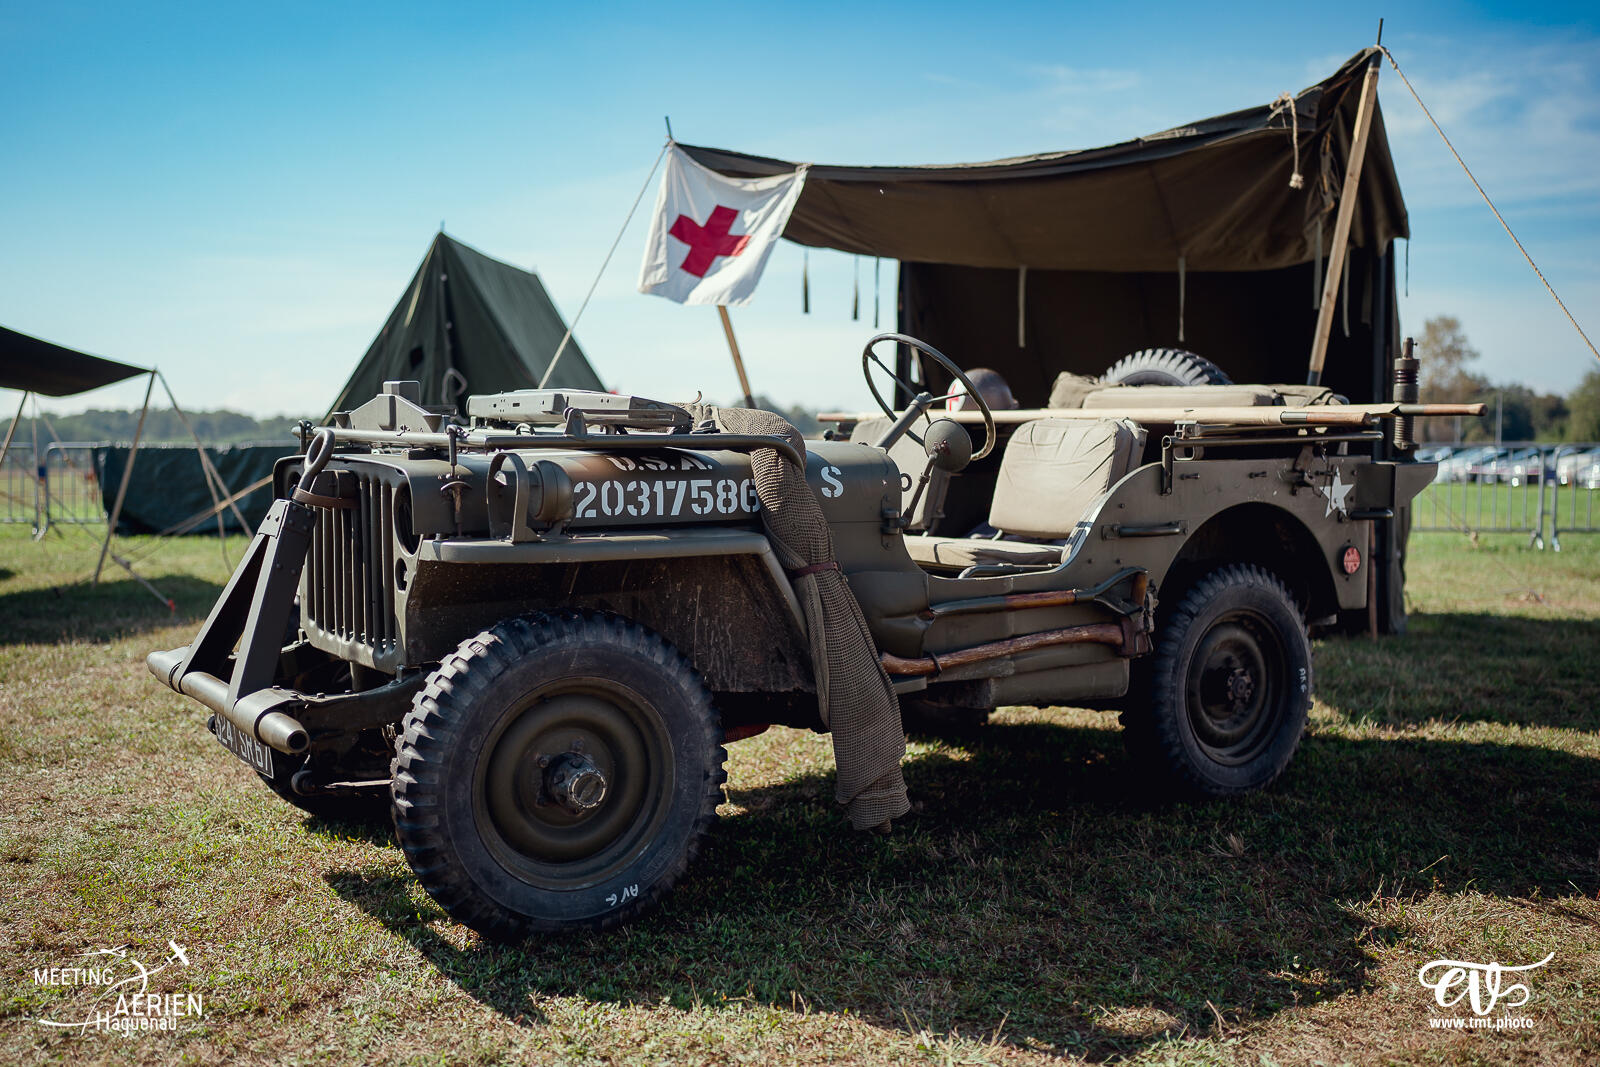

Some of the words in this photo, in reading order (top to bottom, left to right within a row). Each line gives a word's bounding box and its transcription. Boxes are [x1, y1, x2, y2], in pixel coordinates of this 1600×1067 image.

[606, 455, 713, 471] U.S.A.
[573, 478, 761, 518] 20317586
[820, 466, 844, 498] S
